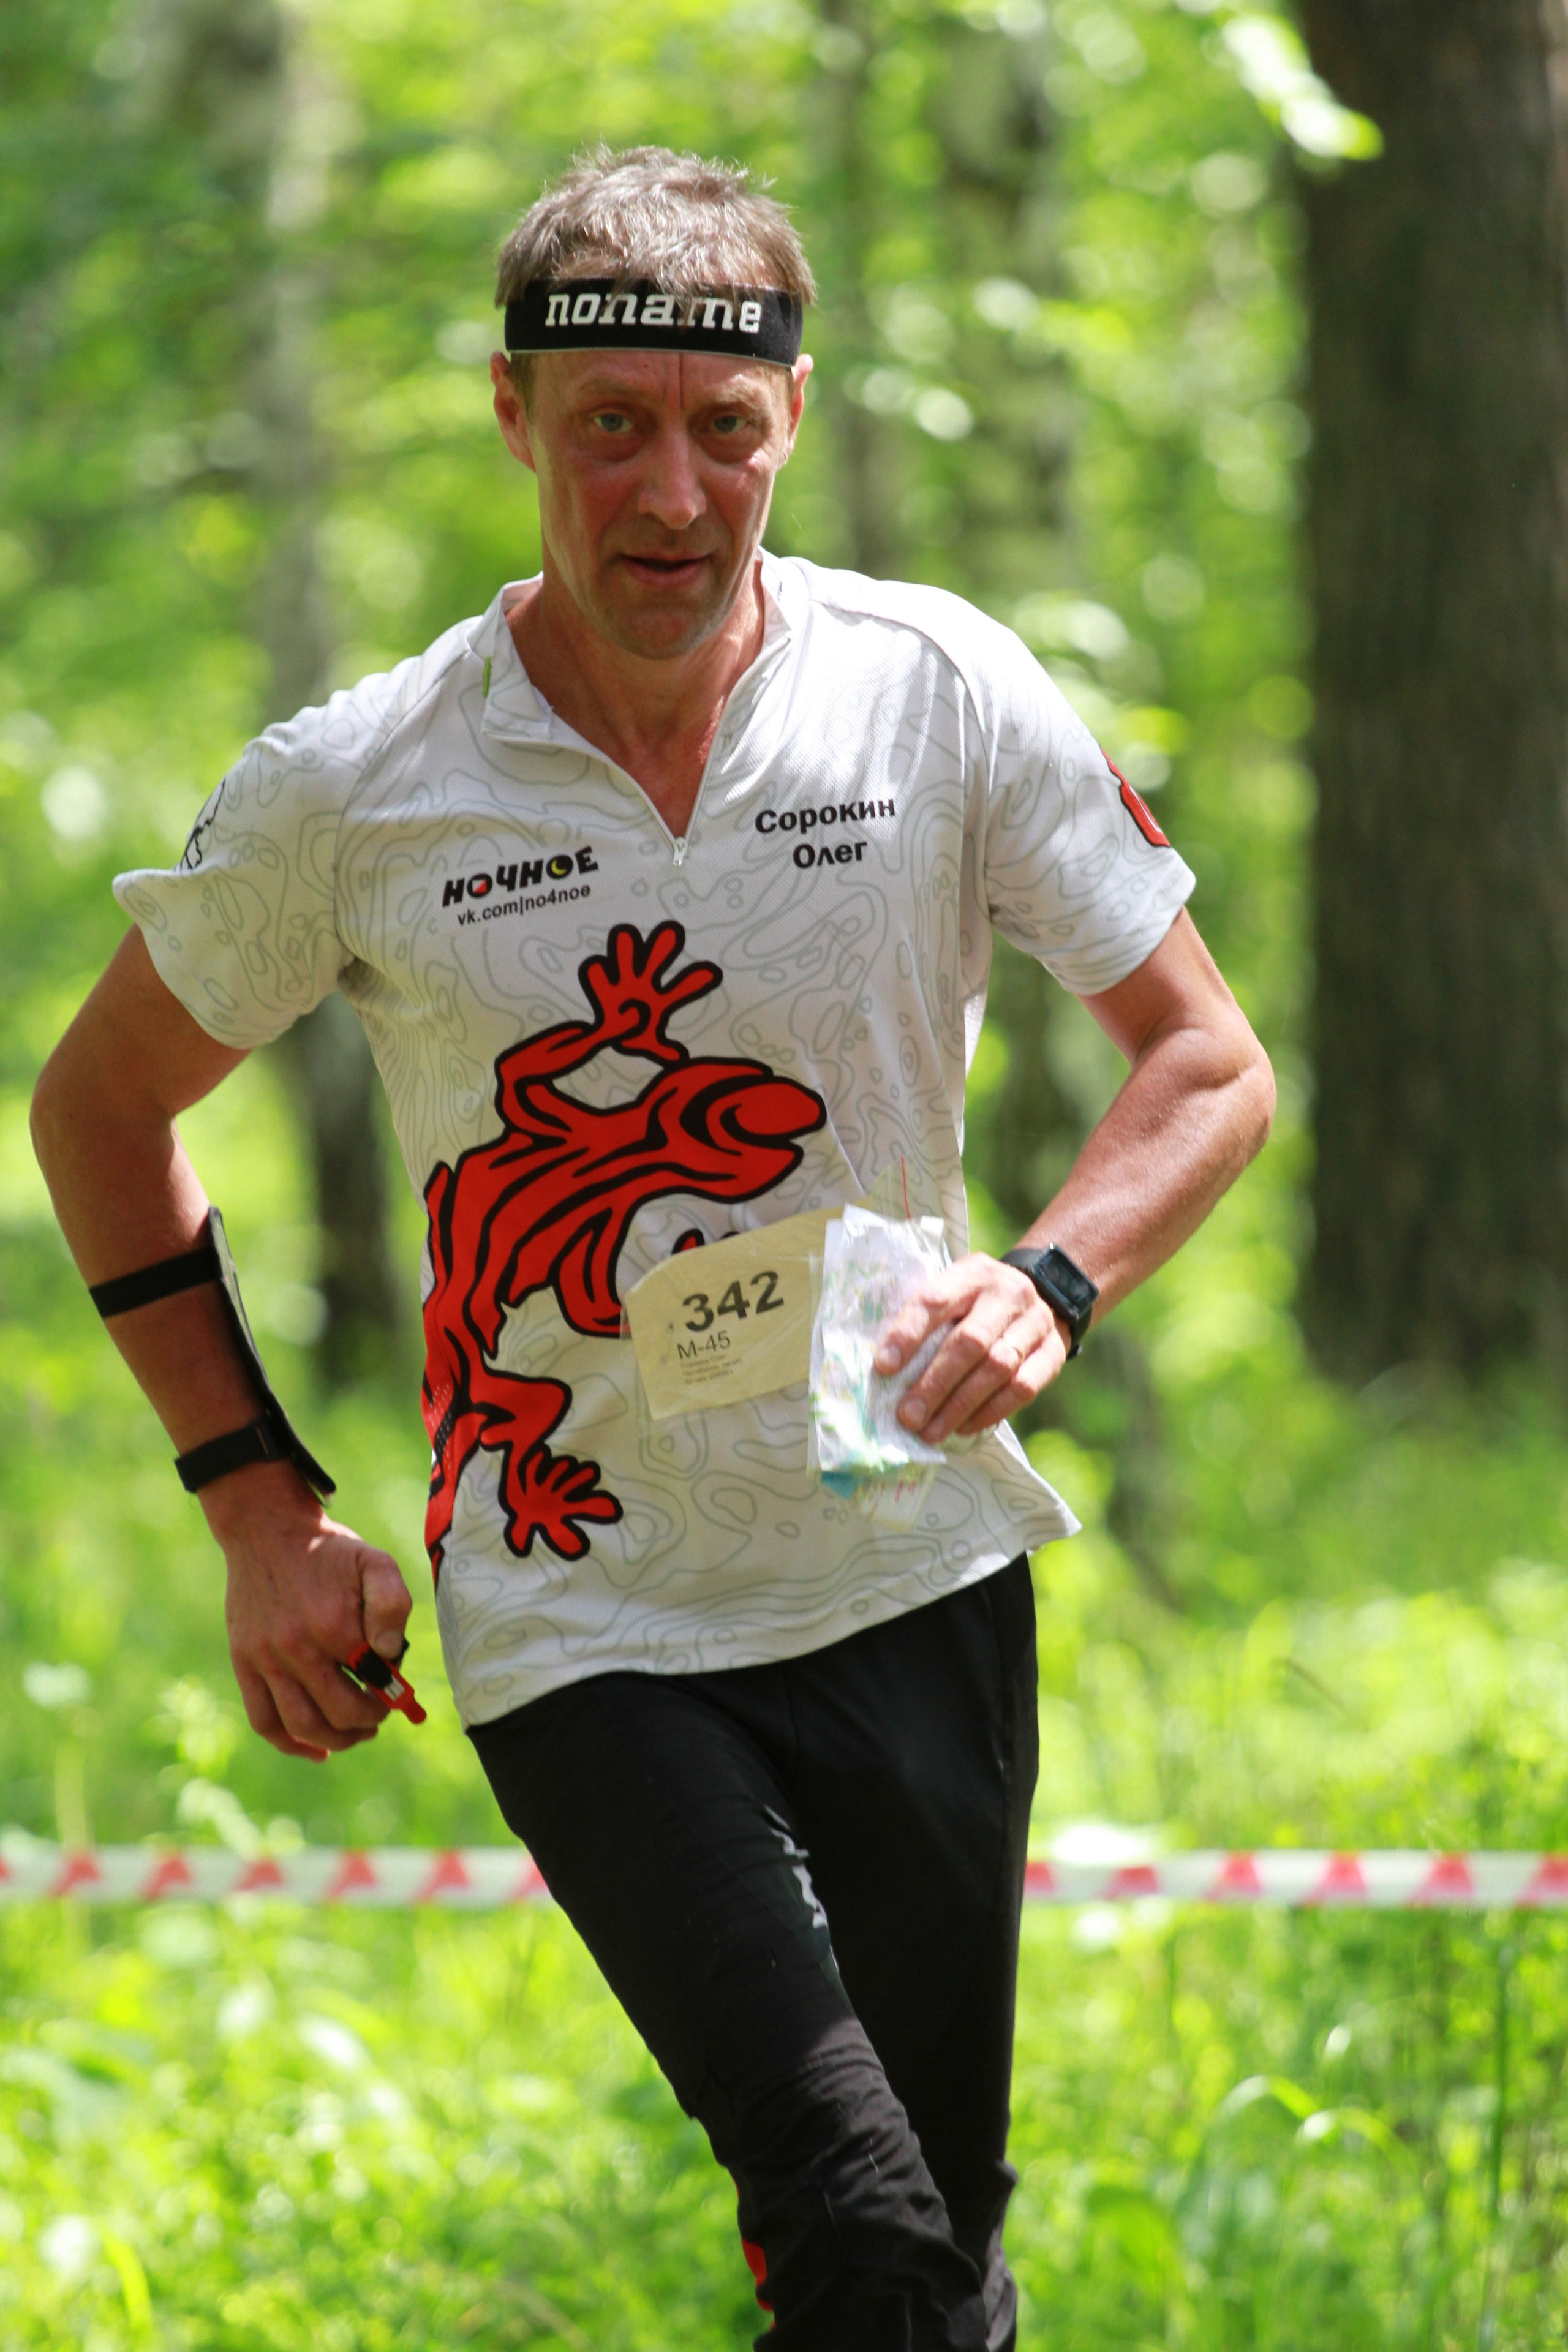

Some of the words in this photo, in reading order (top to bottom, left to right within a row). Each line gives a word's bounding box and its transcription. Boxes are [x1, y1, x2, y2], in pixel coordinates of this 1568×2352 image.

[545, 293, 761, 334] noname
[755, 799, 895, 834] Сорокин
[793, 842, 867, 869] Олег
[442, 845, 599, 908] НОЧНОЕ
[682, 1271, 784, 1332] 342
